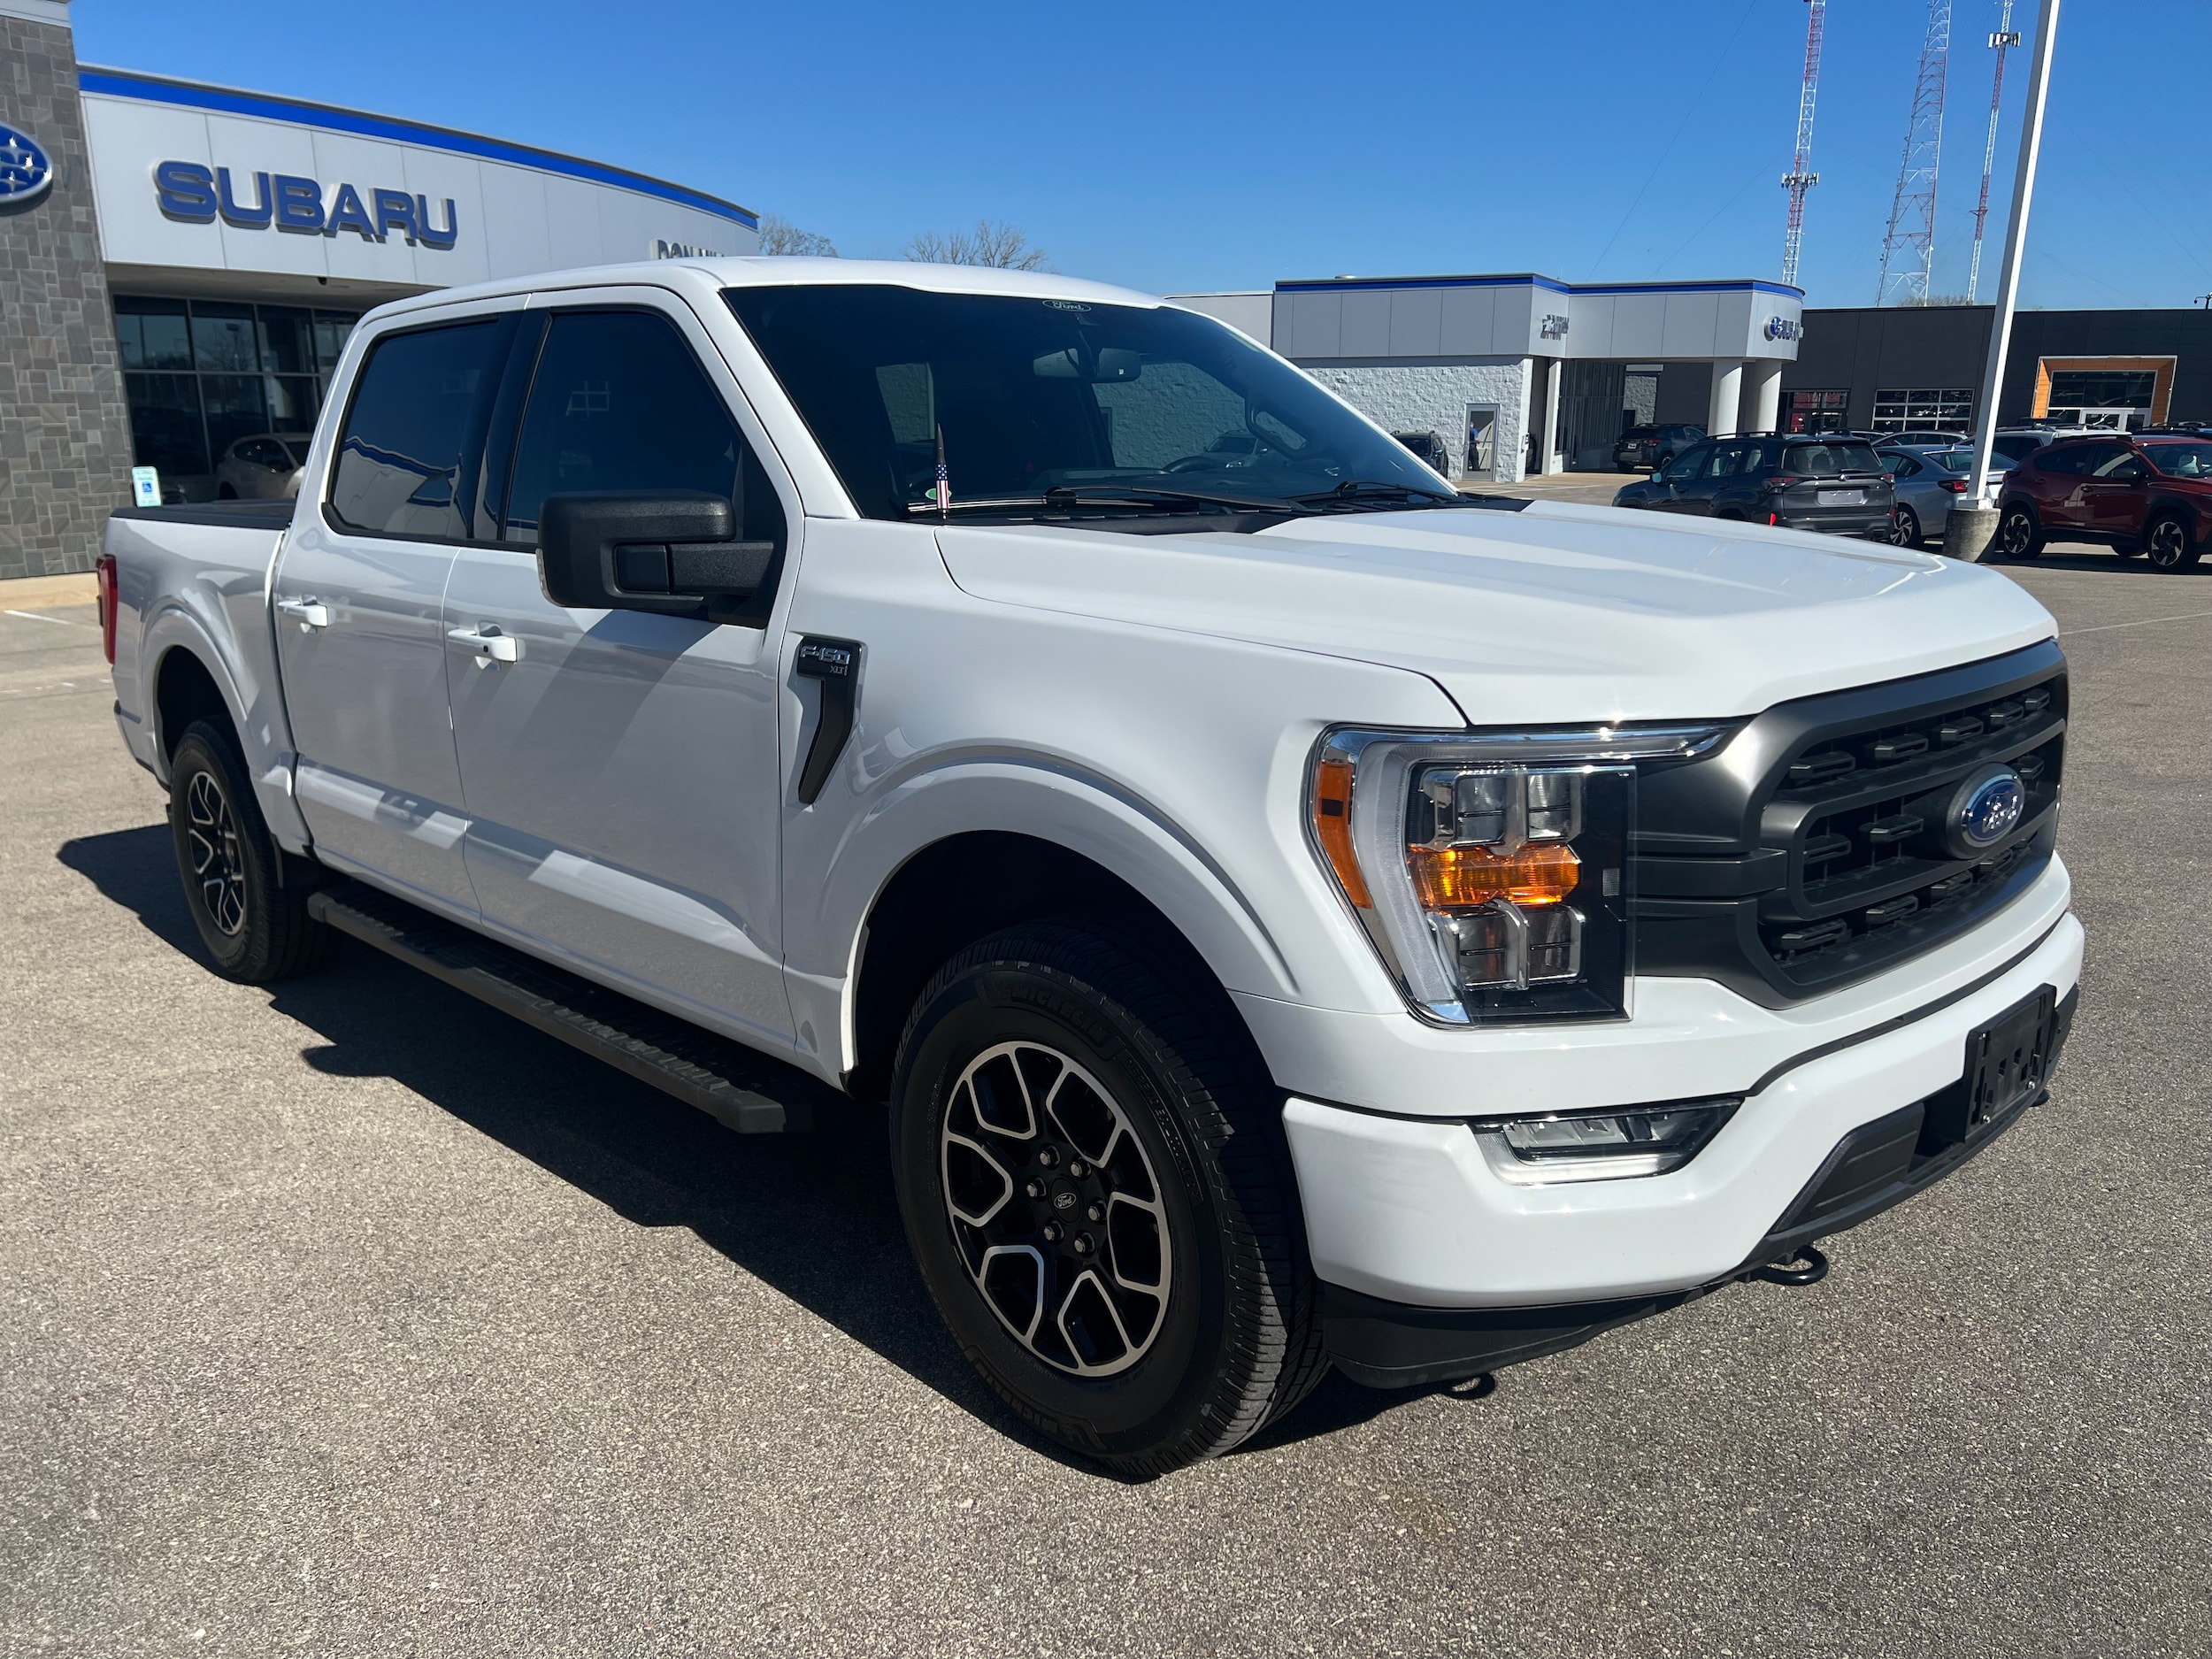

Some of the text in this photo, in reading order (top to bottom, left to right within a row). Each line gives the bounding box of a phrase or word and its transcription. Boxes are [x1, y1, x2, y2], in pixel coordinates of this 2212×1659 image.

[155, 160, 457, 248] SUBARU
[800, 646, 850, 664] F-150
[1011, 987, 1107, 1046] MICHELIN
[1057, 1194, 1072, 1207] Ford
